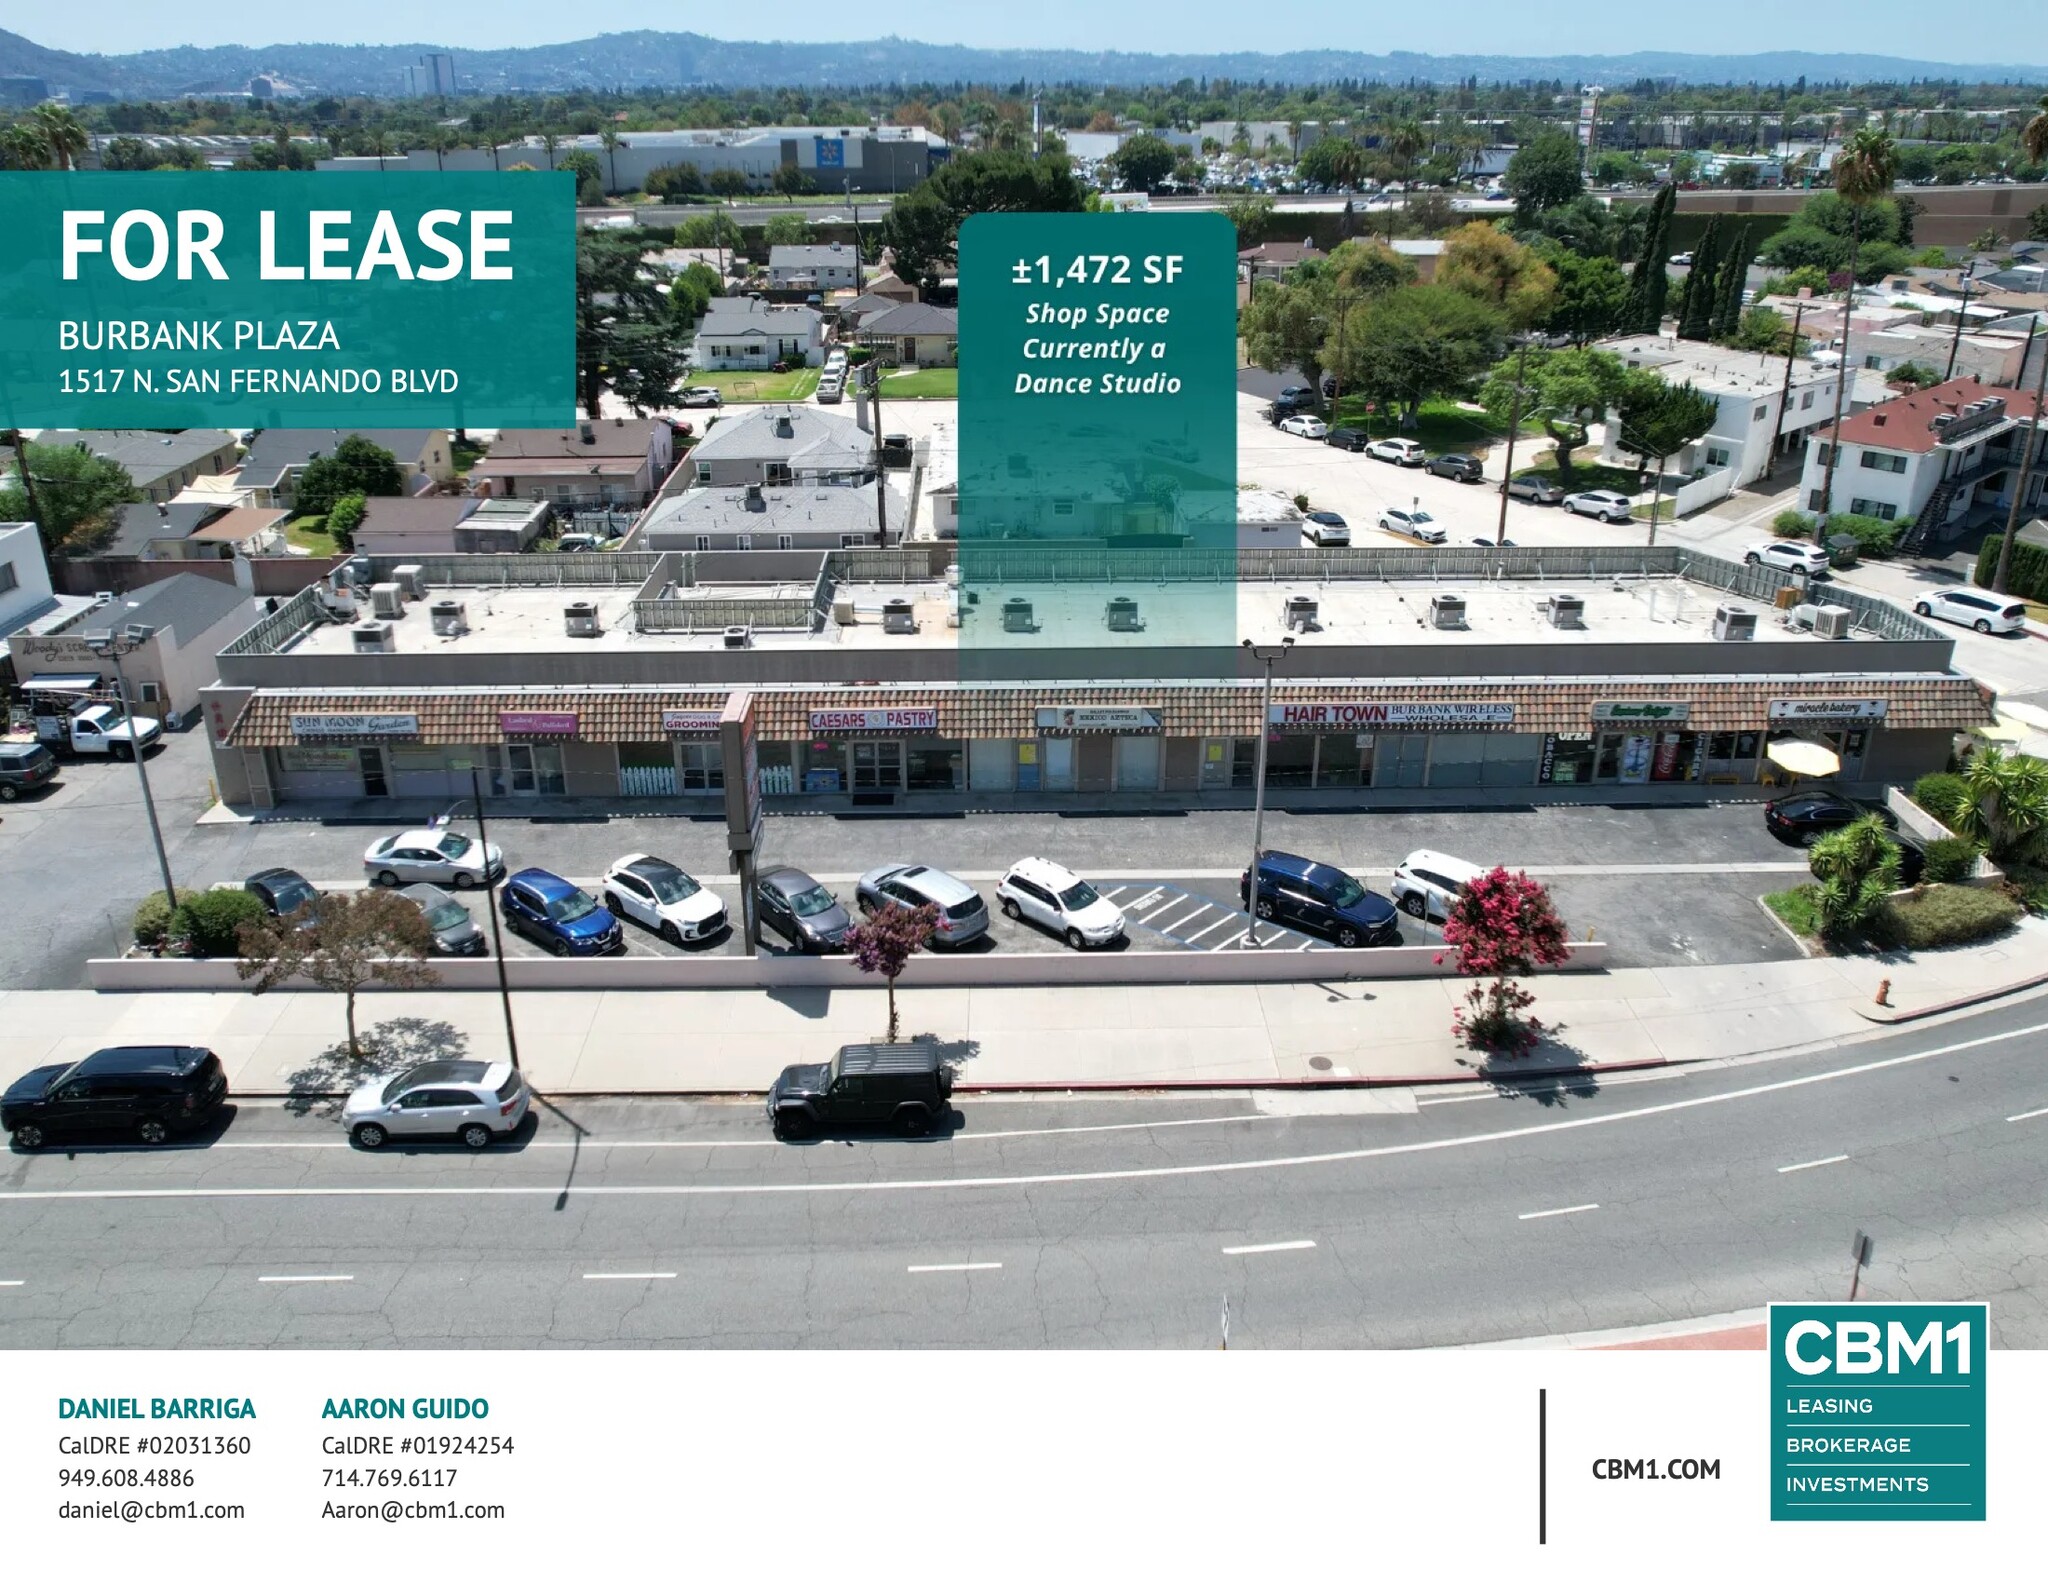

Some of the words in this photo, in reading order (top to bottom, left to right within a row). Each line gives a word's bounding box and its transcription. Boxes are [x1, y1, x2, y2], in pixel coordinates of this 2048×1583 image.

[1284, 705, 1328, 722] HAIR
[1331, 705, 1388, 722] TOWN
[1391, 704, 1452, 715] BURBANK
[1454, 703, 1513, 714] WIRELESS
[295, 716, 321, 728] SUN
[324, 716, 365, 727] MOON
[666, 720, 721, 729] GROOMIN
[811, 713, 866, 728] CAESARS
[887, 711, 935, 727] PASTRY
